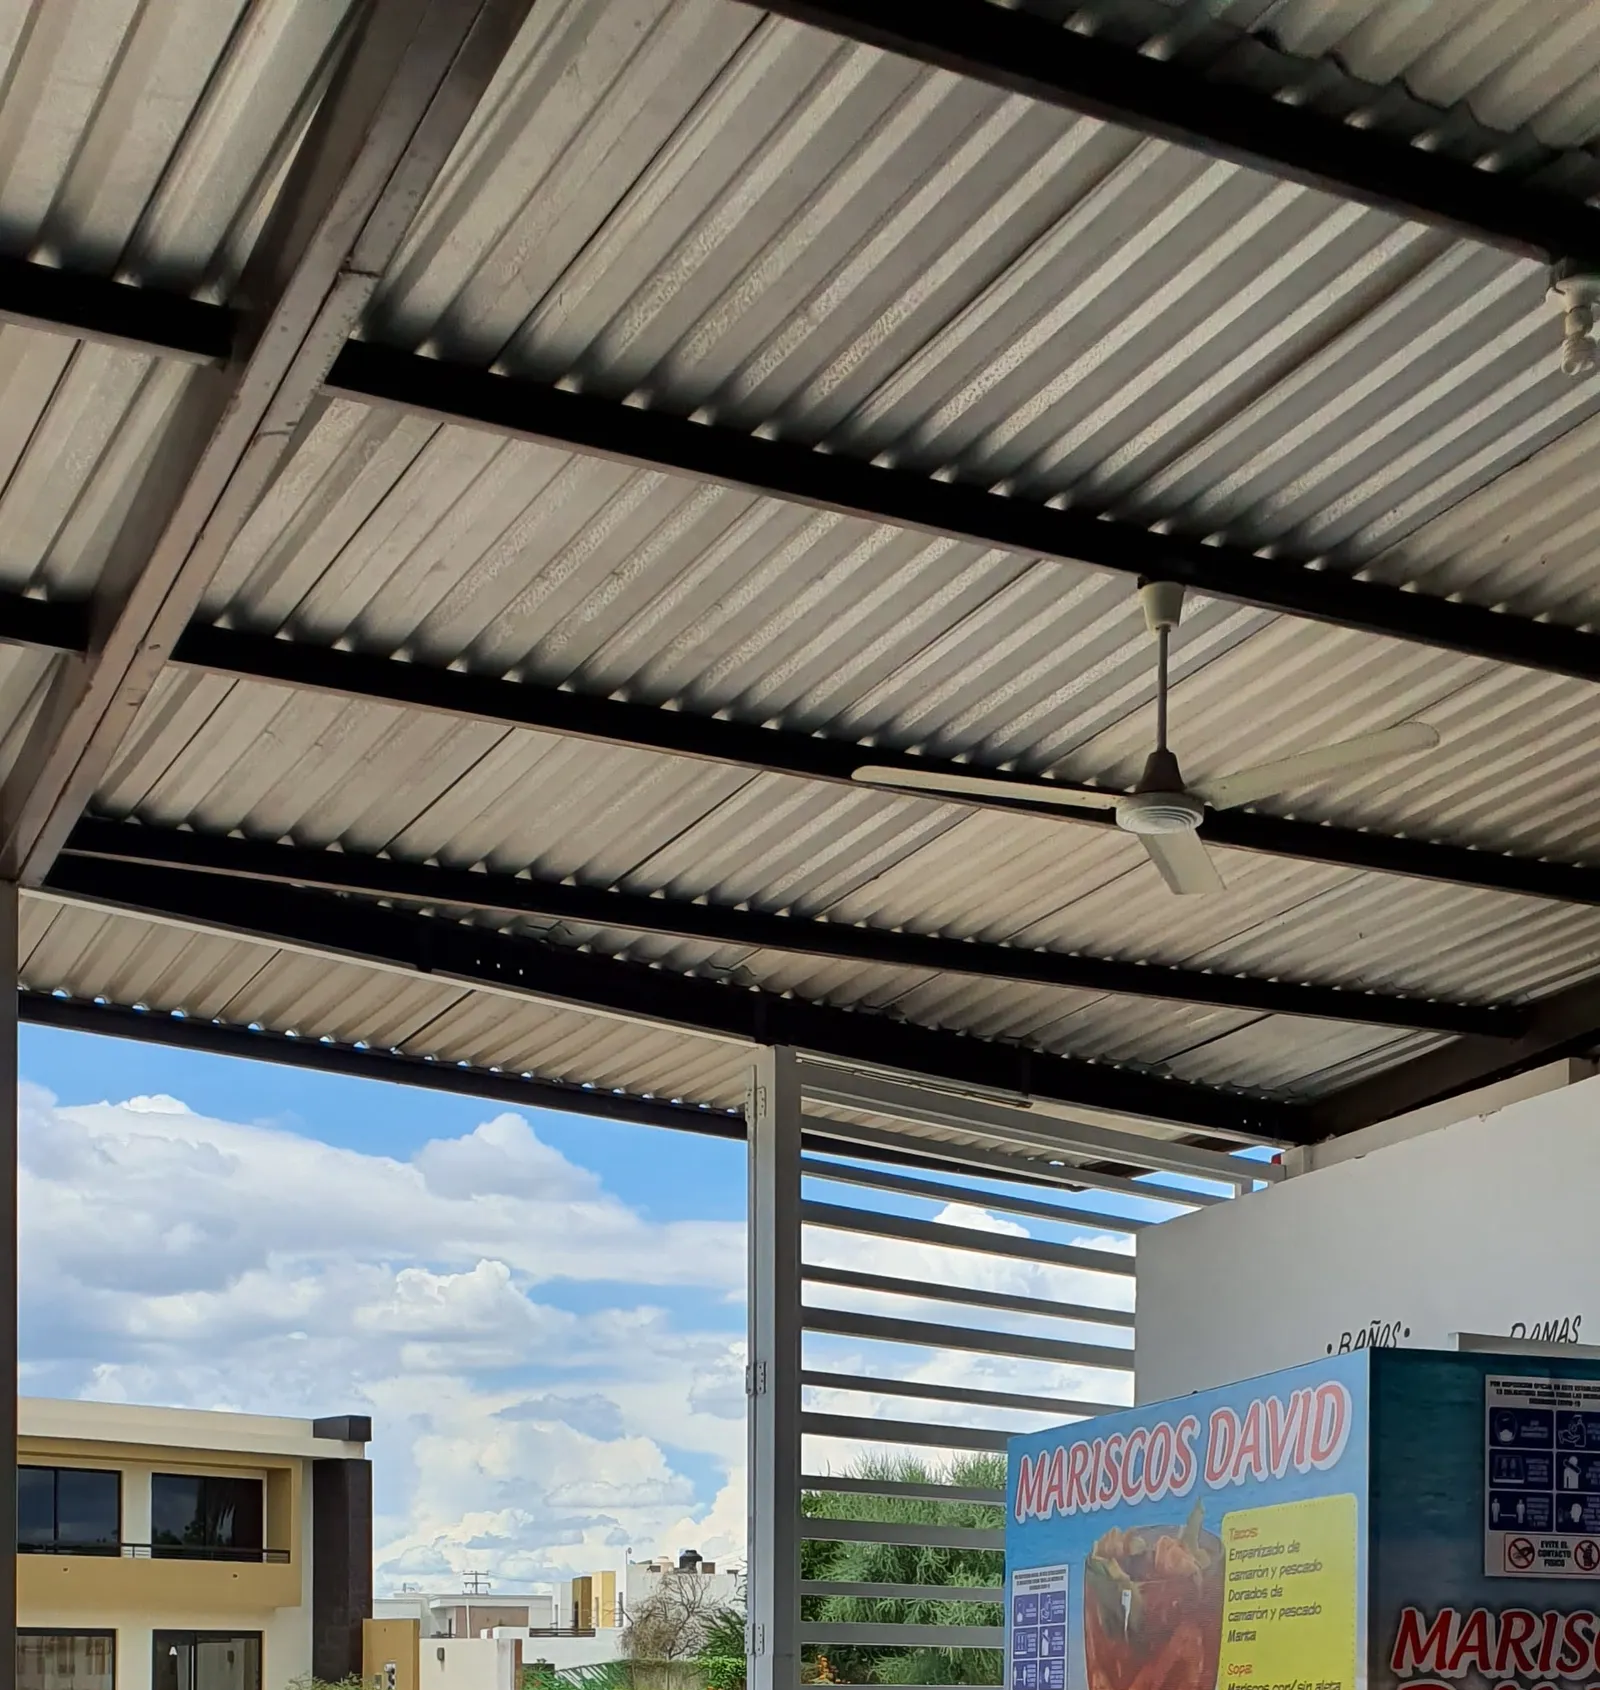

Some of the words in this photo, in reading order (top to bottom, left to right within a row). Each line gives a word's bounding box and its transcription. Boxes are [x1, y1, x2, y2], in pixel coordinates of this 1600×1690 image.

[1338, 1320, 1401, 1355] BAÑOS
[1014, 1415, 1200, 1522] MARISCOS
[1203, 1381, 1350, 1488] DAVID
[1229, 1542, 1284, 1562] Empanizado
[1287, 1540, 1300, 1553] de
[1229, 1565, 1269, 1581] camarón
[1270, 1566, 1278, 1579] y
[1279, 1559, 1322, 1578] pescado
[1228, 1586, 1268, 1602] Dorados
[1271, 1585, 1283, 1598] de
[1228, 1607, 1268, 1622] camarón
[1270, 1607, 1277, 1621] y
[1279, 1602, 1322, 1620] pescado
[1391, 1608, 1600, 1678] MARIS
